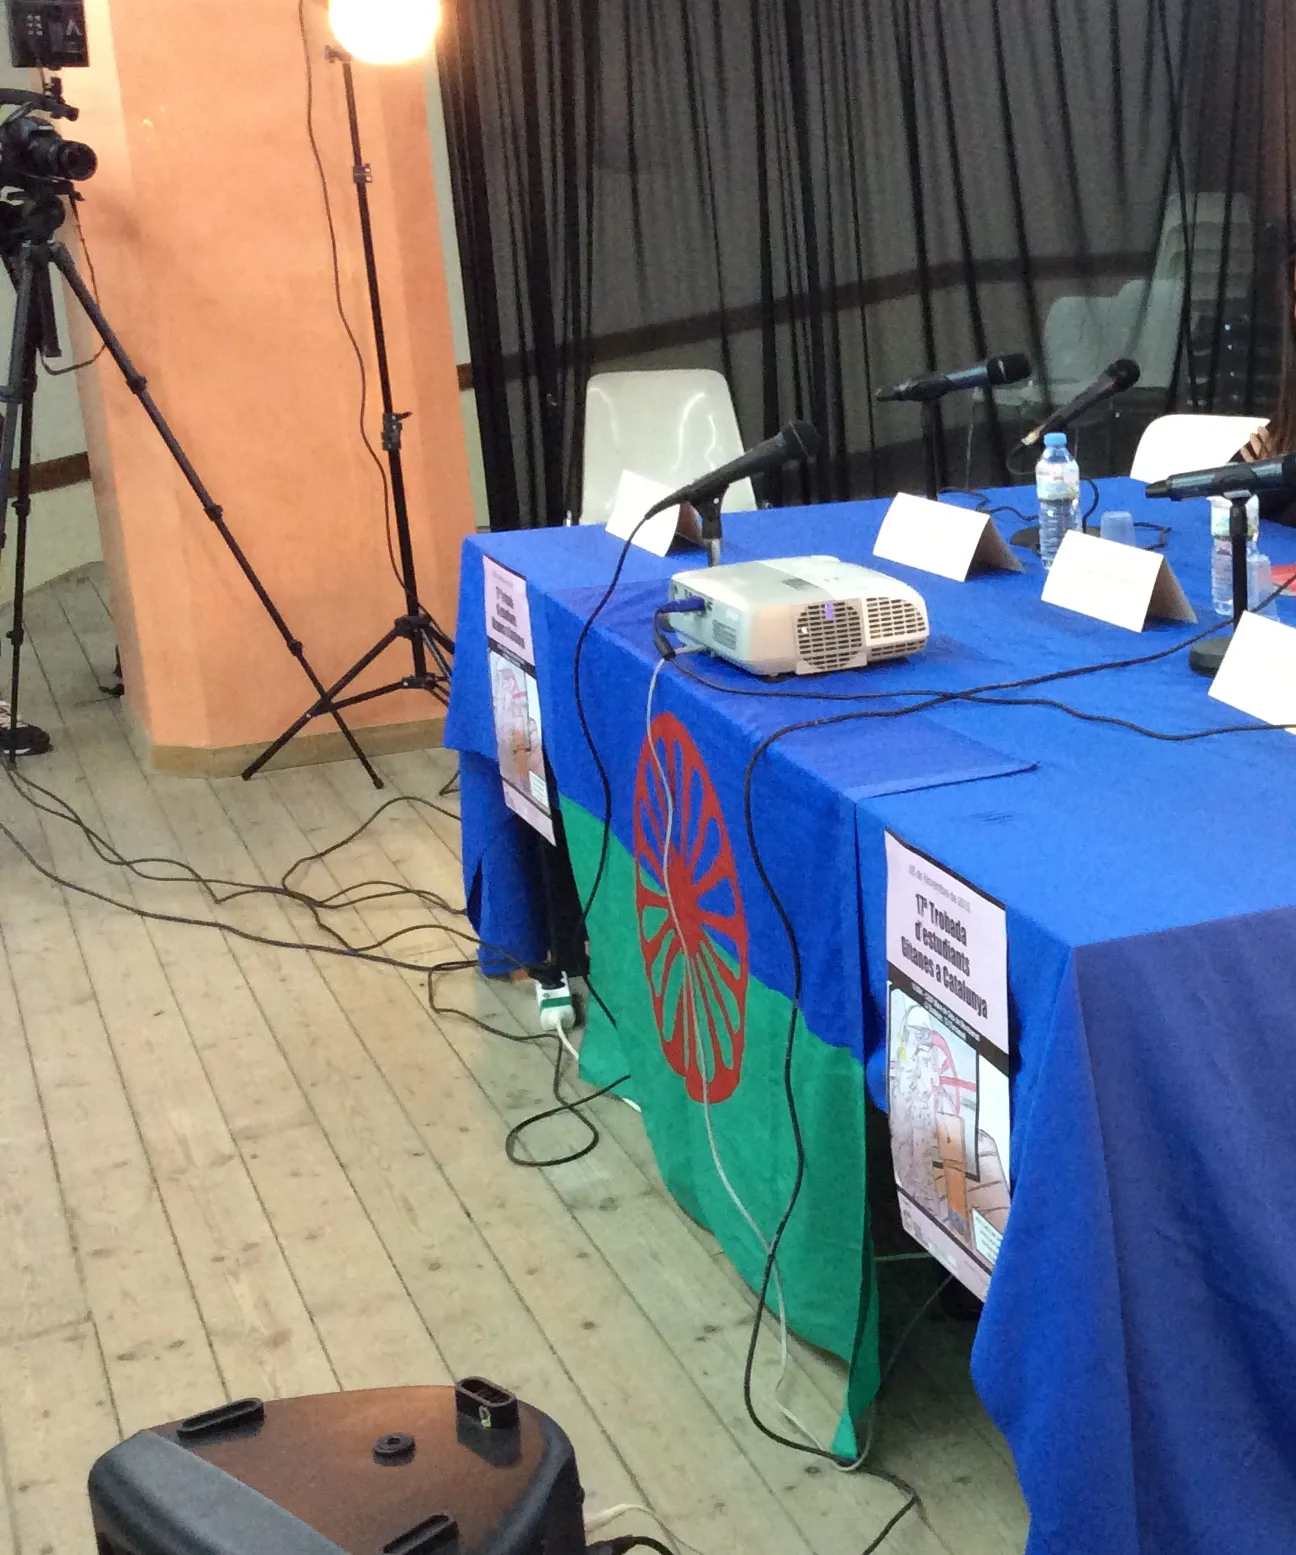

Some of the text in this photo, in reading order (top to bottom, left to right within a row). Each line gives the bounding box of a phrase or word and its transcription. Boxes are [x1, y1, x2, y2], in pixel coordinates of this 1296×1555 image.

[915, 920, 971, 977] d'estudiants
[929, 900, 968, 946] Trobada
[901, 936, 934, 978] Gitanes
[935, 963, 942, 983] a
[943, 965, 988, 1019] Catalunya
